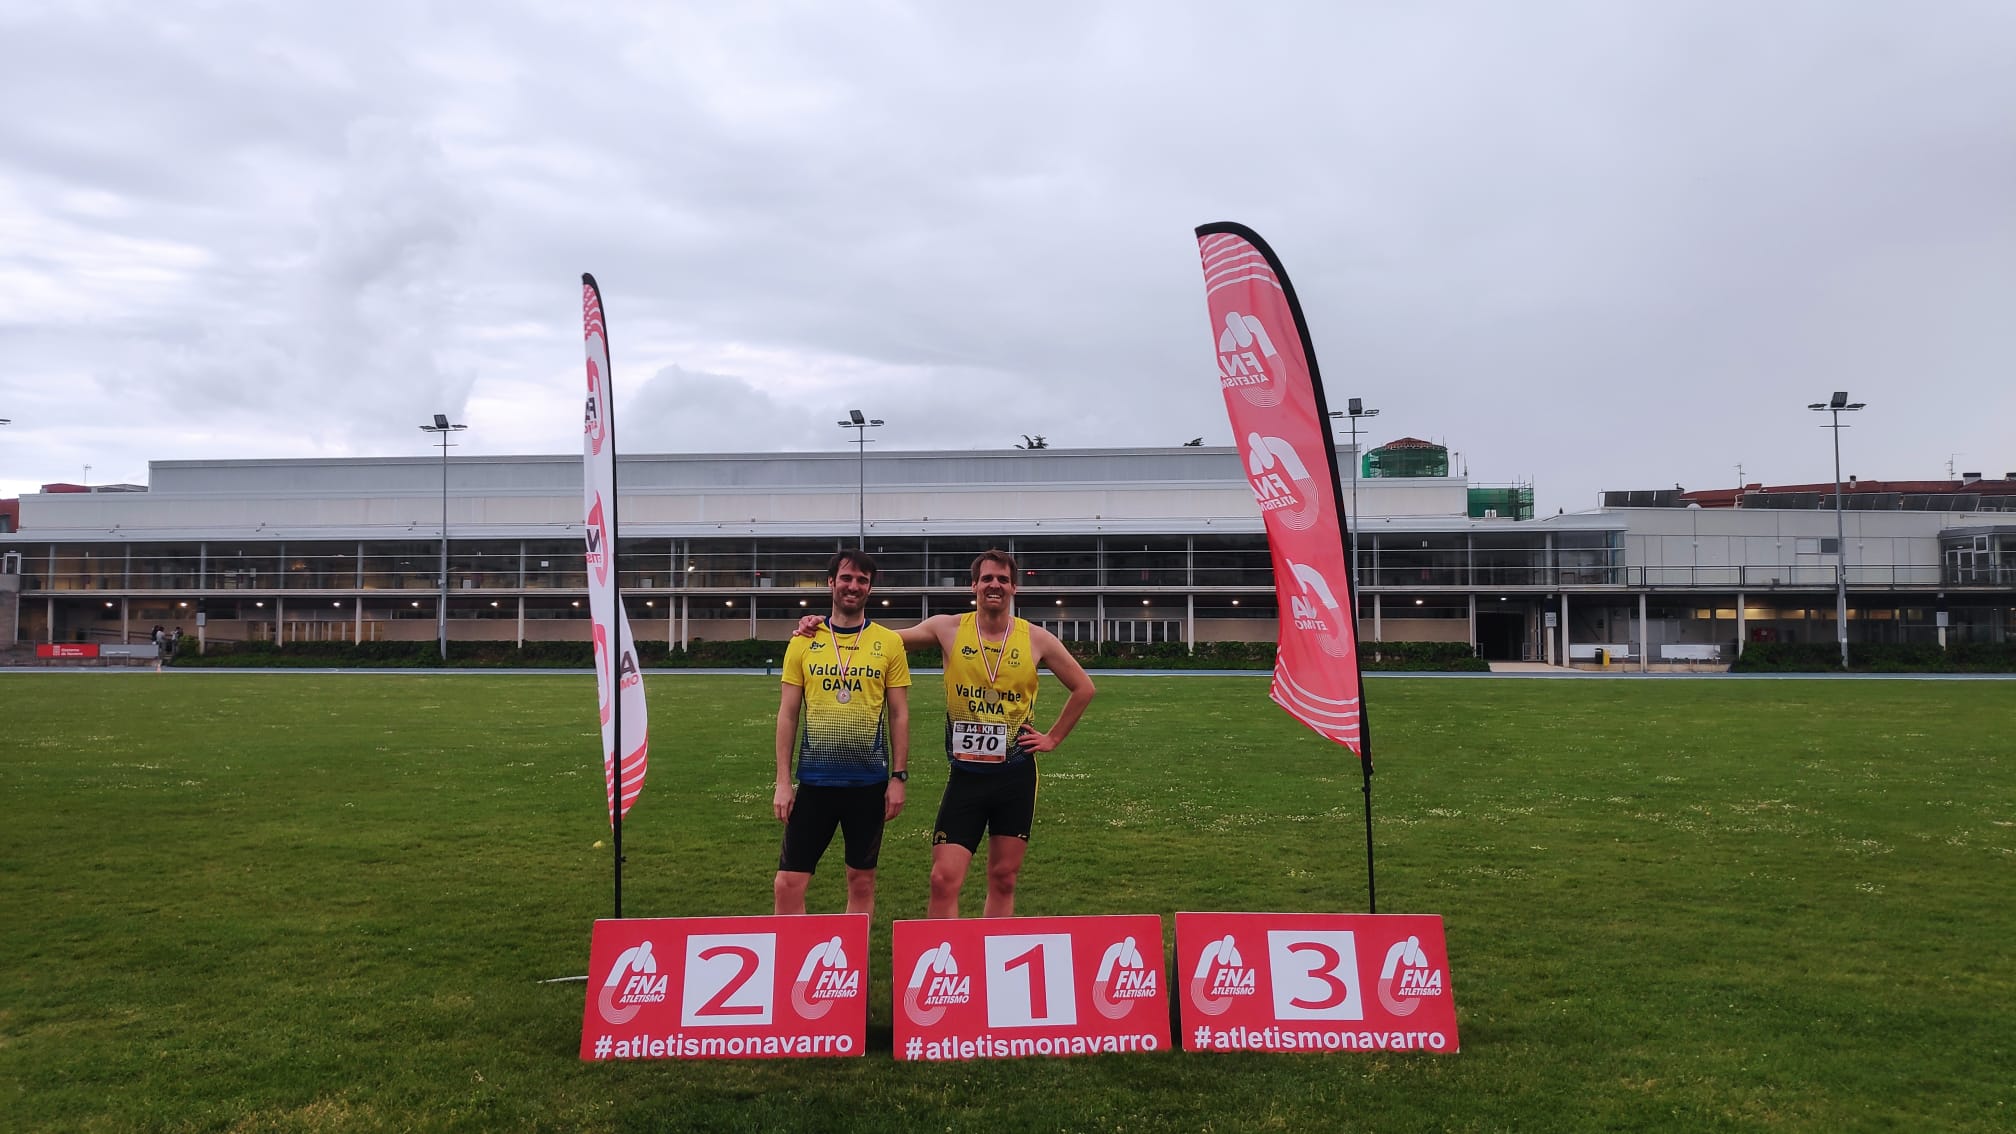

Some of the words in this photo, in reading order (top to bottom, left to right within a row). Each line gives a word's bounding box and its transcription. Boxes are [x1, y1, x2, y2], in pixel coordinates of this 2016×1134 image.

[822, 678, 863, 692] GANA
[956, 683, 1022, 702] Valdirbe
[968, 700, 1005, 714] GANA
[962, 735, 999, 751] 510
[623, 975, 669, 995] FNA
[694, 945, 764, 1016] 2
[815, 970, 860, 990] FNA
[1004, 943, 1048, 1018] 1
[1115, 970, 1156, 990] FNA
[1213, 968, 1256, 987] FNA
[1287, 941, 1348, 1010] 3
[1400, 969, 1442, 988] FNA
[812, 989, 858, 999] ATLETISMO
[927, 976, 971, 996] FNA
[1112, 989, 1157, 999] ATLETISMO
[1210, 986, 1256, 996] ATLETISMO
[1398, 987, 1442, 996] ATLETISMO
[619, 994, 666, 1004] ATLETISMO
[924, 995, 970, 1005] ATLETISMO
[594, 1033, 853, 1060] #atletismonavarro
[1194, 1025, 1446, 1049] #atletismonavarro
[905, 1034, 1158, 1061] #atletismonavarro
